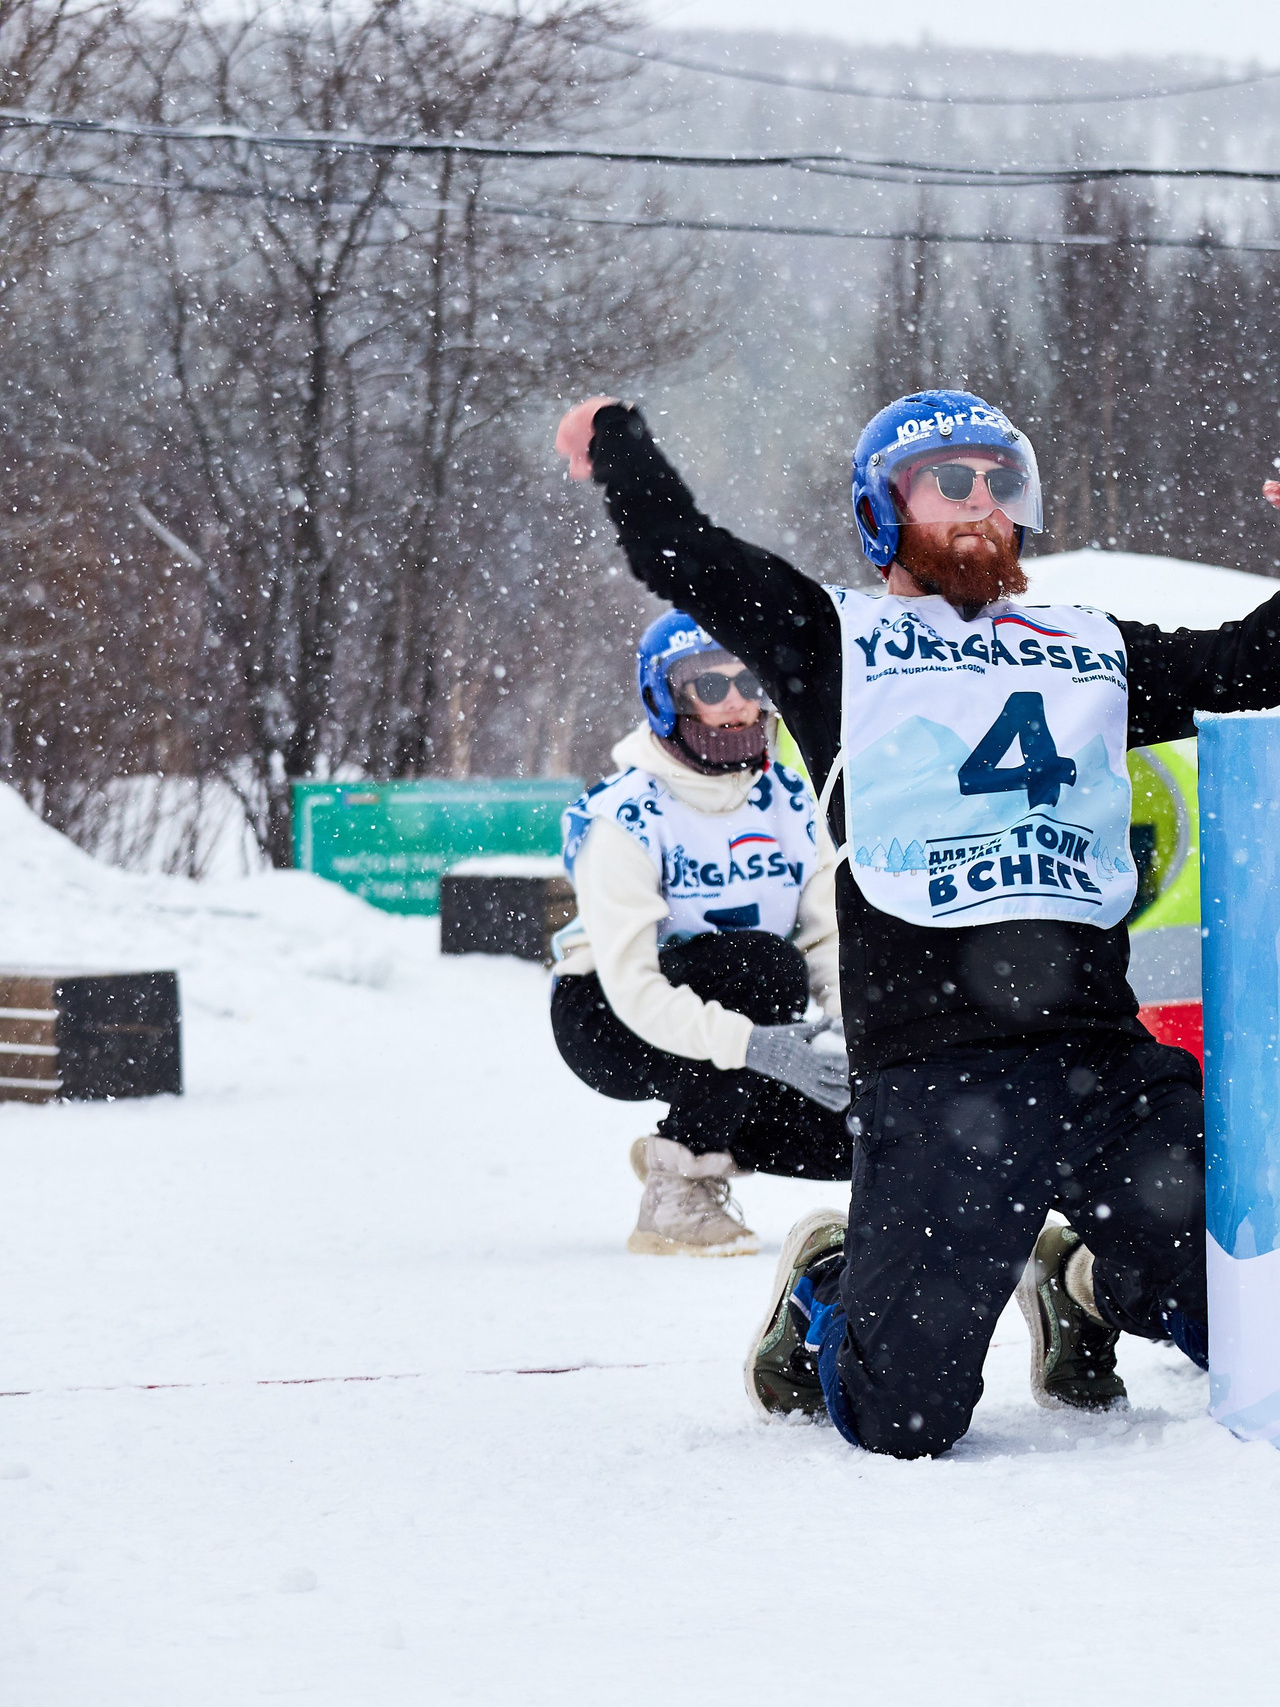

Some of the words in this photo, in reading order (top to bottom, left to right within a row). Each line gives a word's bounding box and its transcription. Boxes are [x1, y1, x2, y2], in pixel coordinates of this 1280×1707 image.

[956, 663, 986, 675] REGION
[1071, 674, 1117, 685] СНЕЖНЫЙ
[958, 691, 1077, 811] 4
[1010, 824, 1090, 866] ТОЛК
[929, 847, 966, 866] ДЛЯ
[929, 863, 957, 876] КТО
[928, 873, 958, 907] В
[967, 853, 1103, 895] СНЕГЕ
